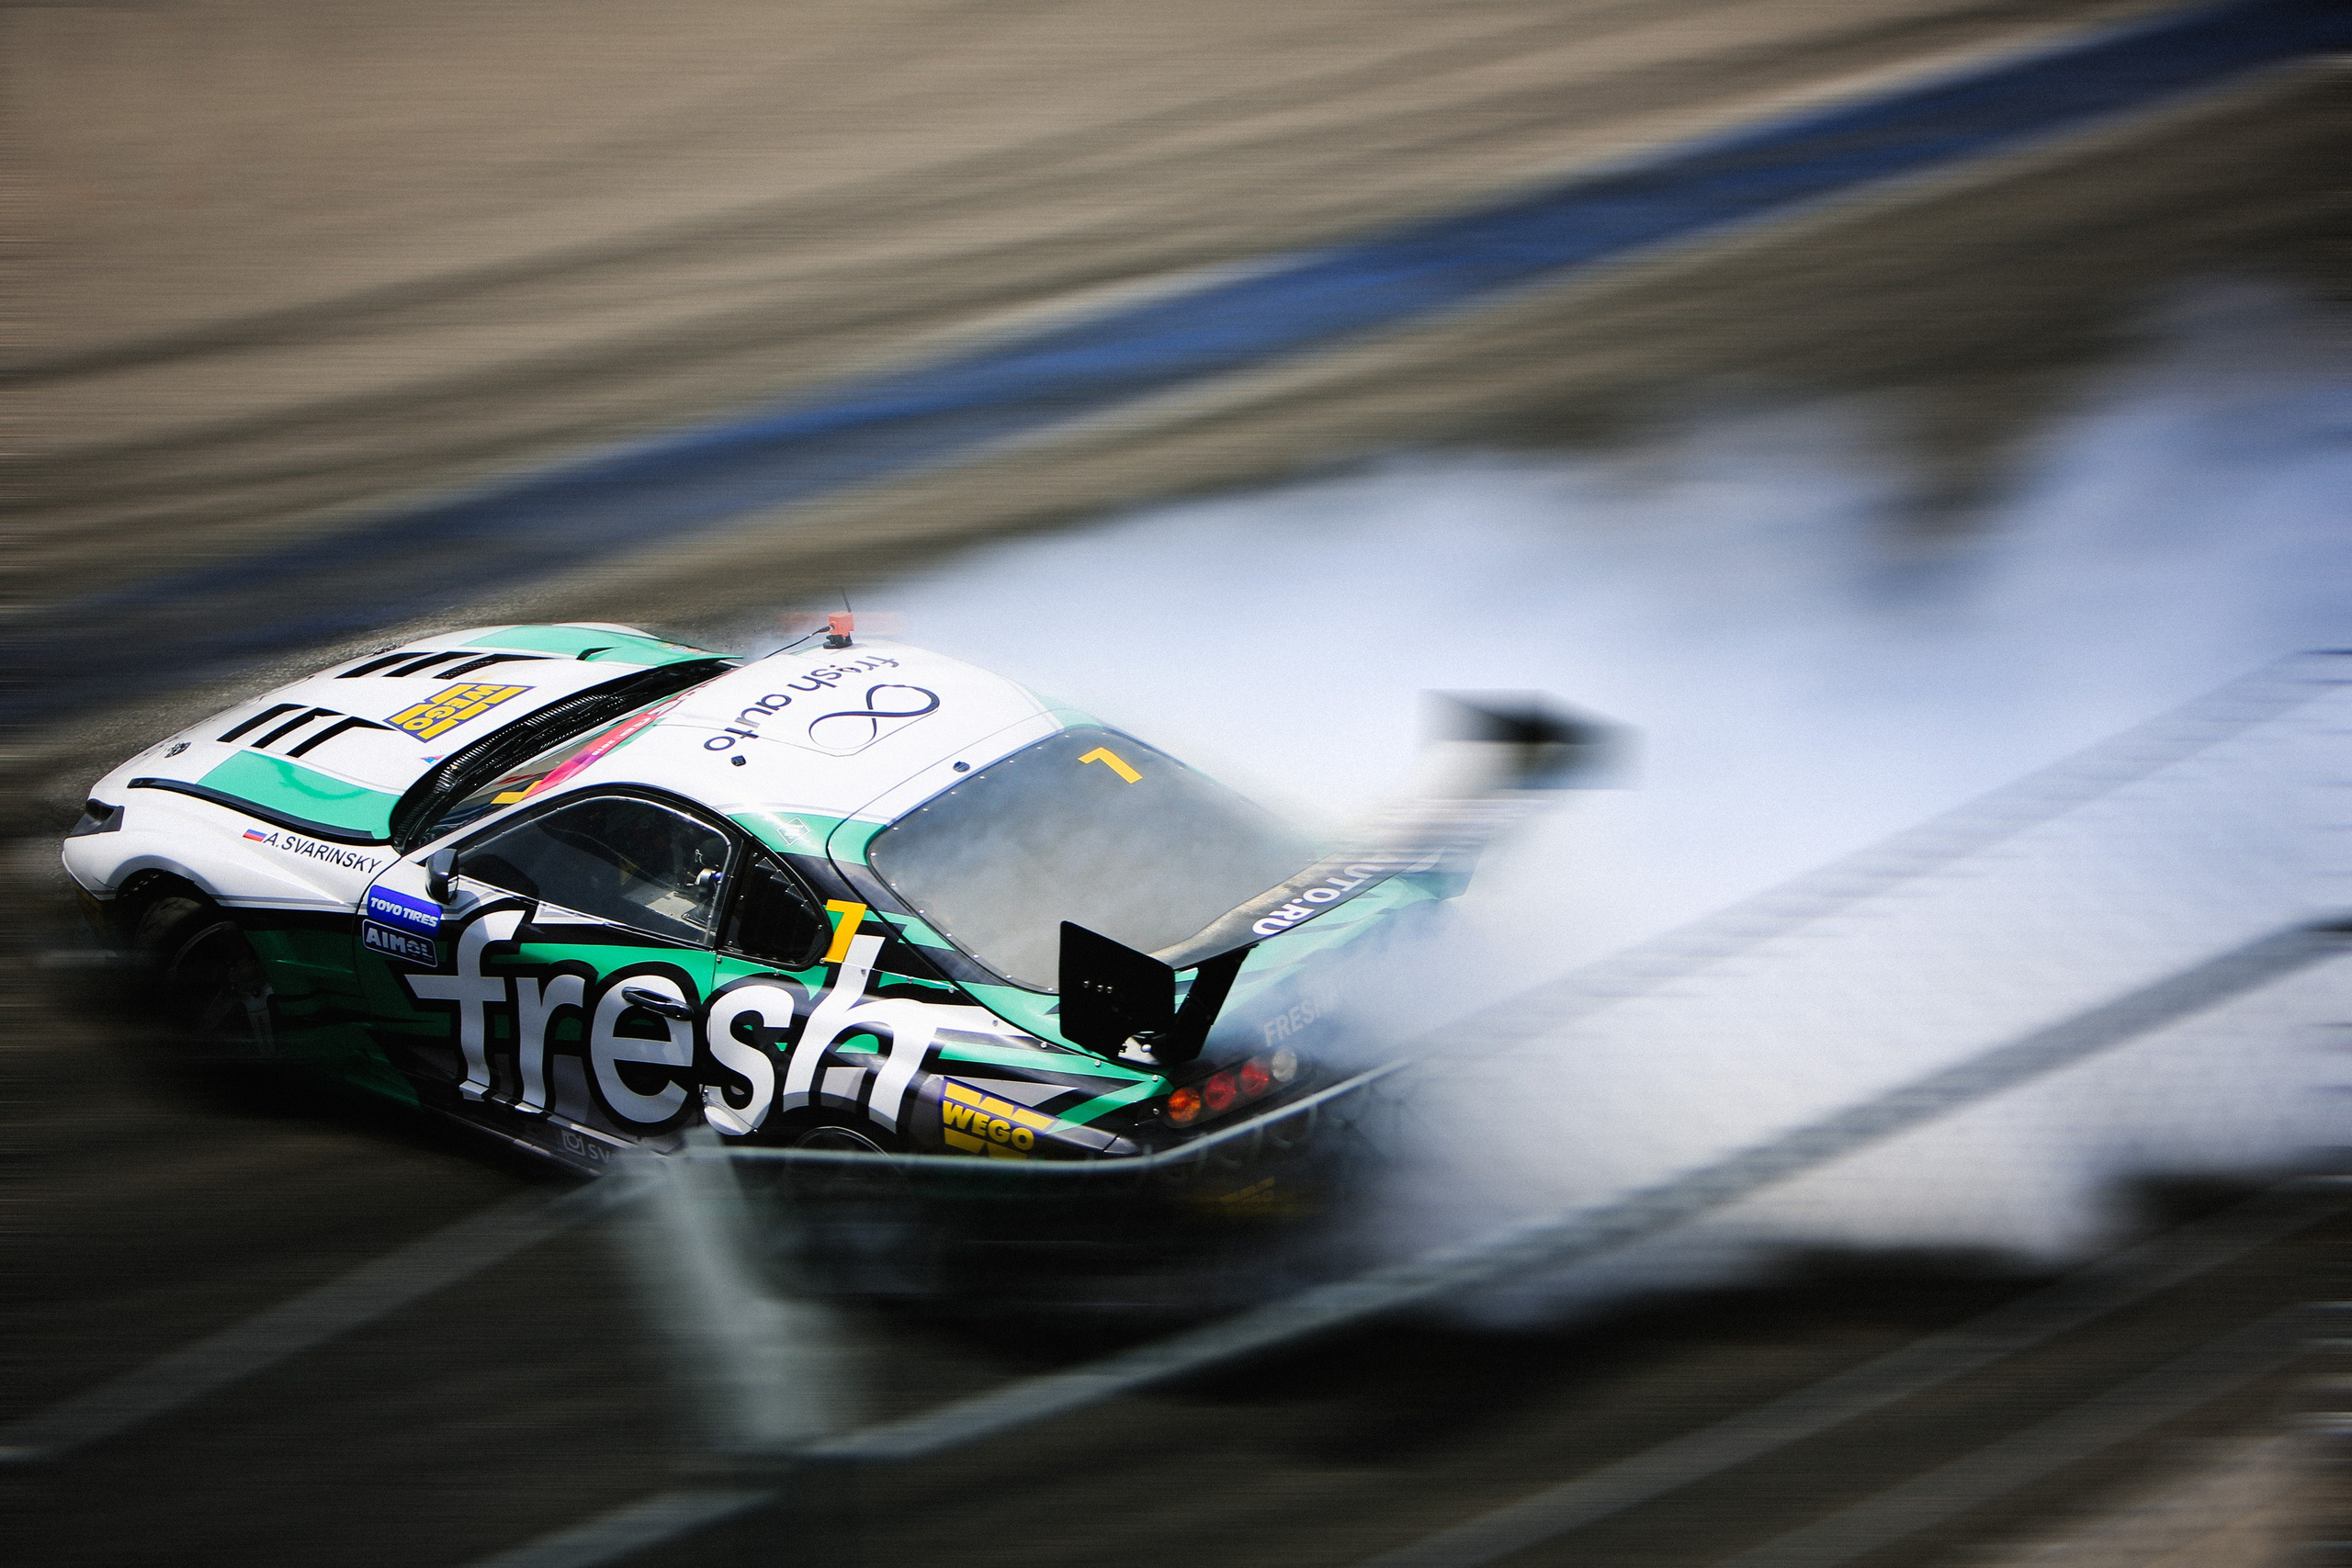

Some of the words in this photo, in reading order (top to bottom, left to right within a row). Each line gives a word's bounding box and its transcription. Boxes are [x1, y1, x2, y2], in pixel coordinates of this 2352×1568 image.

[787, 655, 899, 692] fresh
[402, 684, 506, 731] WEGO
[703, 693, 793, 751] auto
[1078, 746, 1143, 784] 7
[370, 897, 402, 916] TOYO
[403, 907, 438, 928] TIRES
[1251, 856, 1395, 936] UTO.RU
[366, 927, 434, 962] AIMOL
[824, 899, 867, 964] 7
[402, 909, 939, 1136] fresh
[942, 1100, 1035, 1151] WEGO
